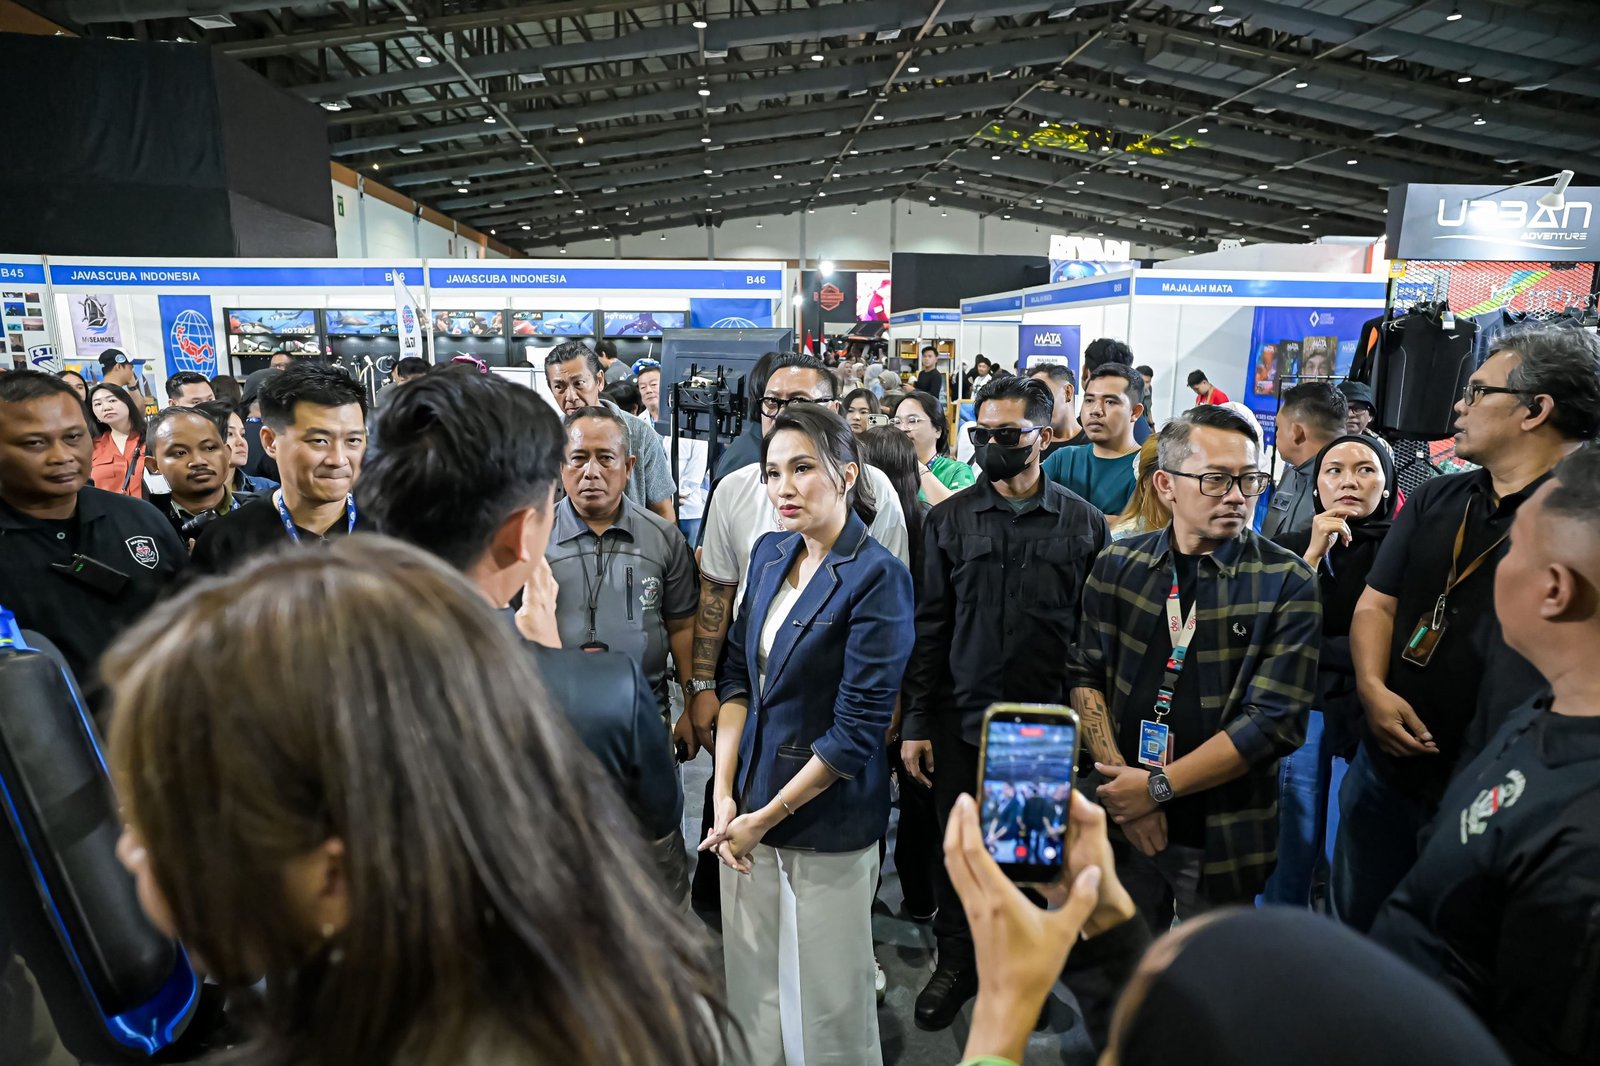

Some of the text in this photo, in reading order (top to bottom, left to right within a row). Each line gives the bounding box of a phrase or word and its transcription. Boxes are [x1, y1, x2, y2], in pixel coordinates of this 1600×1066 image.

[1519, 231, 1588, 241] ADVENTURE
[1, 269, 24, 278] B45
[71, 271, 201, 282] JAVASCUBA INDONESIA
[385, 272, 405, 282] B6
[446, 273, 567, 284] JAVASCUBA INDONESIA
[746, 275, 766, 285] B46
[1161, 282, 1233, 293] MAJALAH MATA
[1034, 331, 1062, 344] MATA
